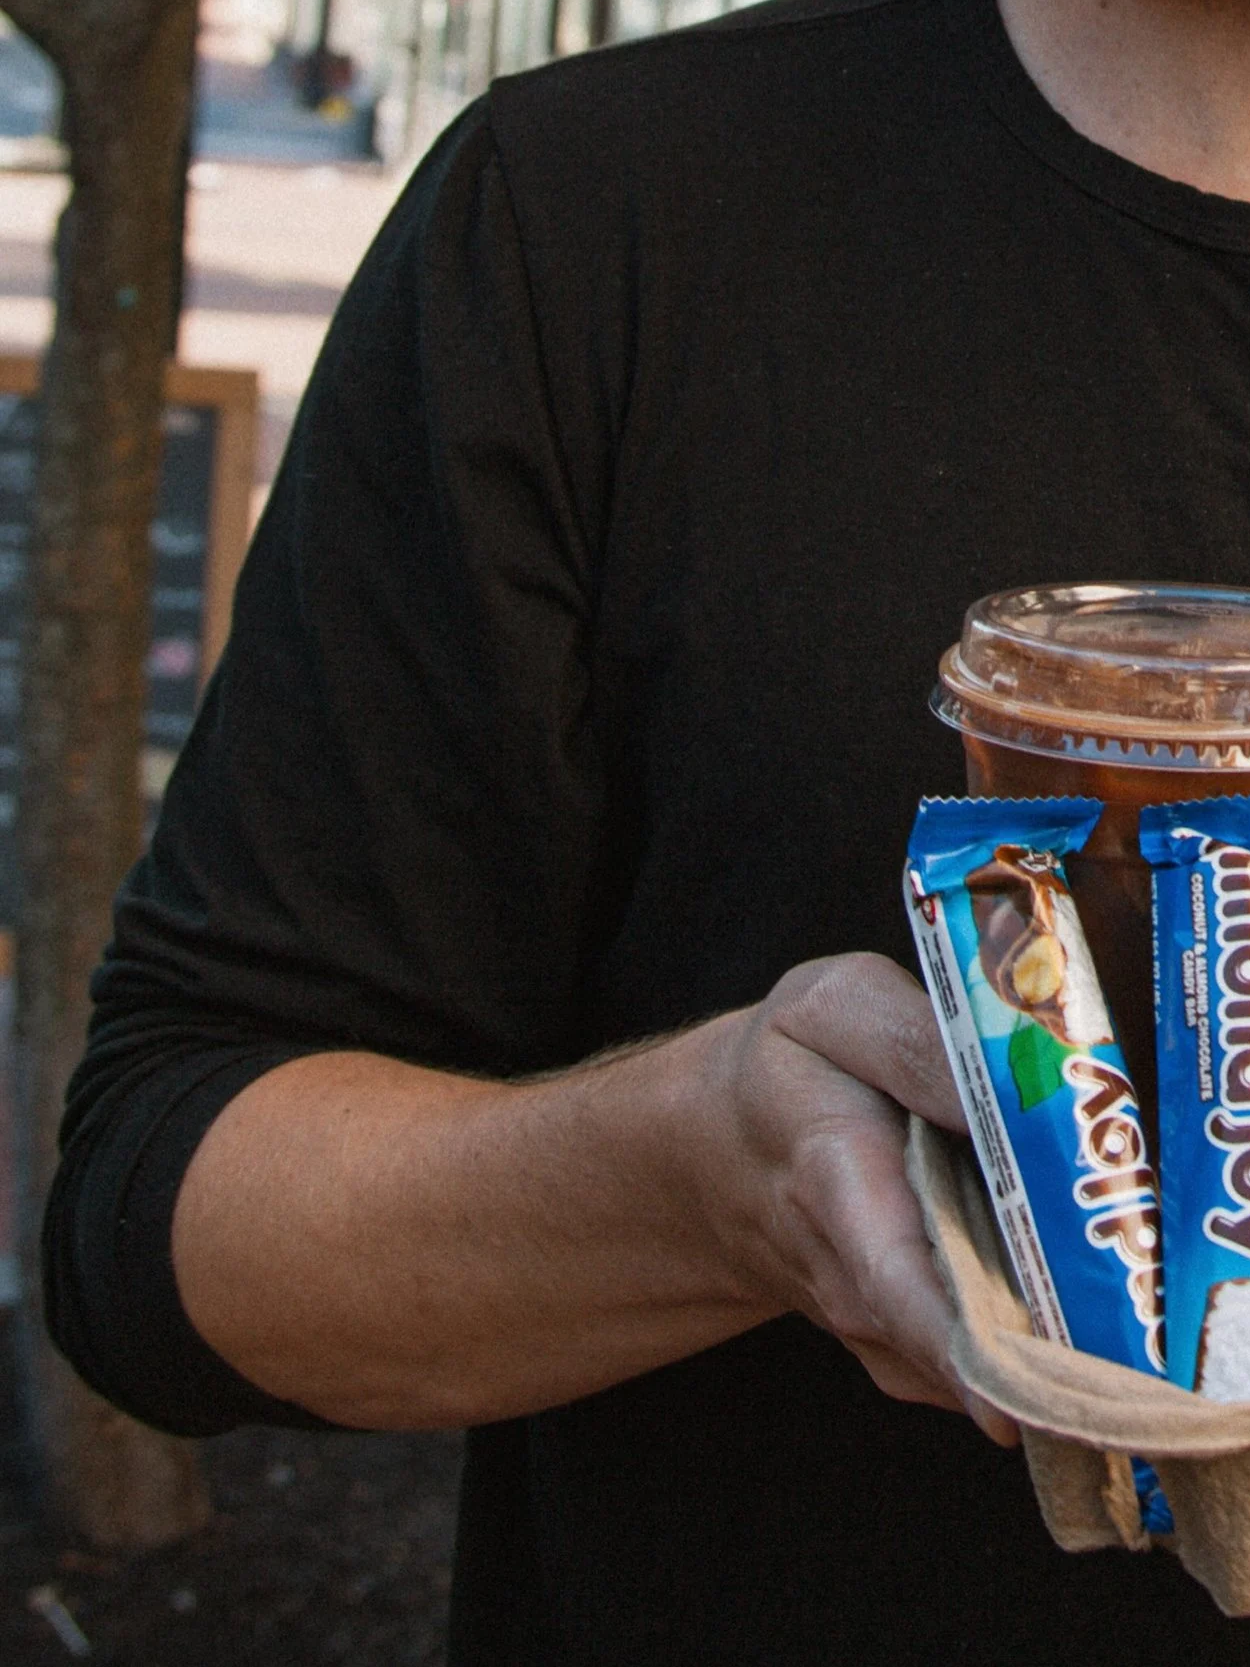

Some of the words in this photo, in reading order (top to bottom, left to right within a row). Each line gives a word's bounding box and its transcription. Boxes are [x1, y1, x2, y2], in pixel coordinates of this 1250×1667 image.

[1190, 872, 1207, 941] COCONUT
[1182, 949, 1196, 995] CANDY
[1193, 943, 1207, 956] &
[1194, 956, 1209, 1015] ALMOND
[1185, 997, 1197, 1027] BAR
[1196, 1016, 1213, 1101] CHOCOLATE
